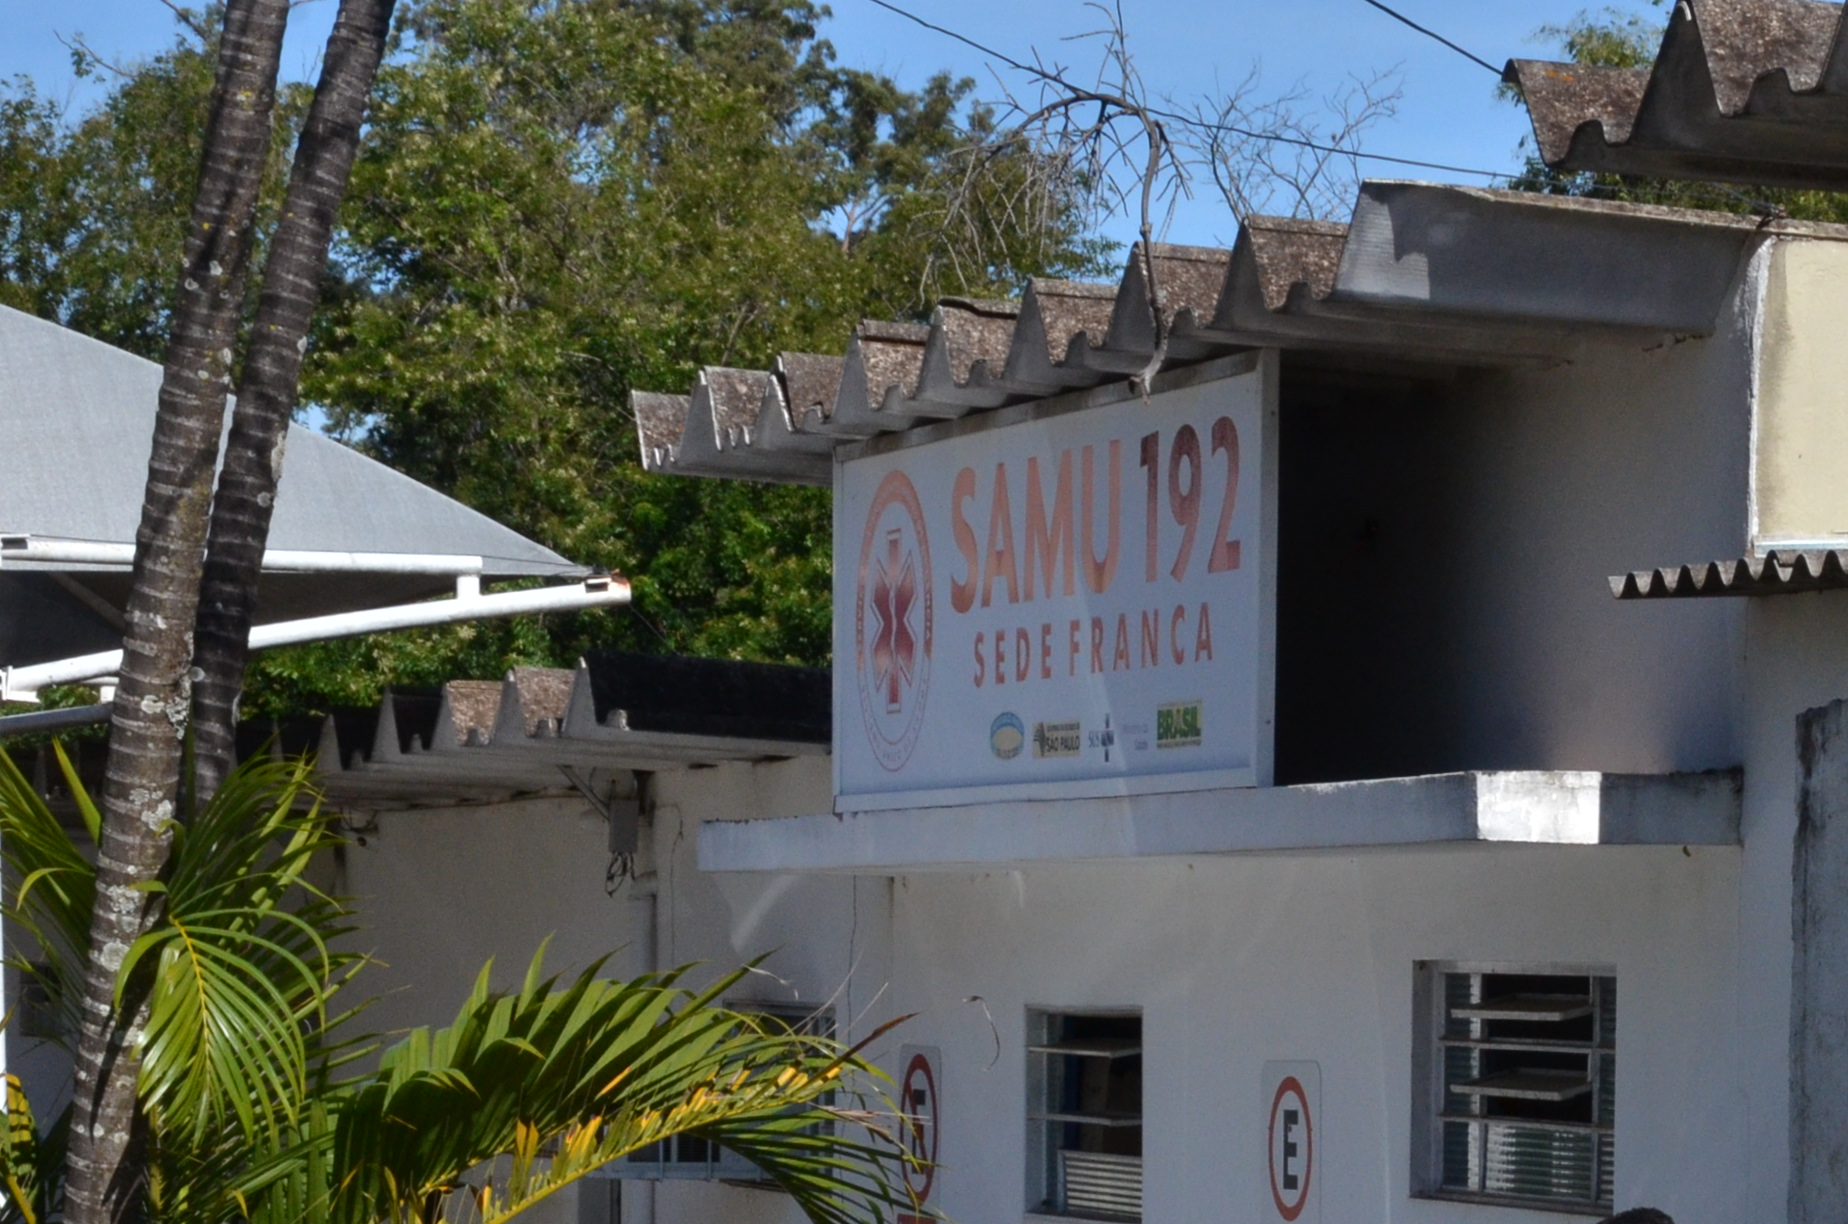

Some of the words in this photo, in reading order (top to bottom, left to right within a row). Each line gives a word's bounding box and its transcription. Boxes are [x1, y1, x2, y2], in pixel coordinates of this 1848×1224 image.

[950, 440, 1122, 614] SAMU
[1140, 415, 1241, 584] 192
[974, 623, 1053, 689] SEDE
[1069, 602, 1213, 677] FRANCA
[1060, 735, 1080, 752] PAULO
[1157, 705, 1202, 741] BRASIL
[1283, 1109, 1299, 1191] E
